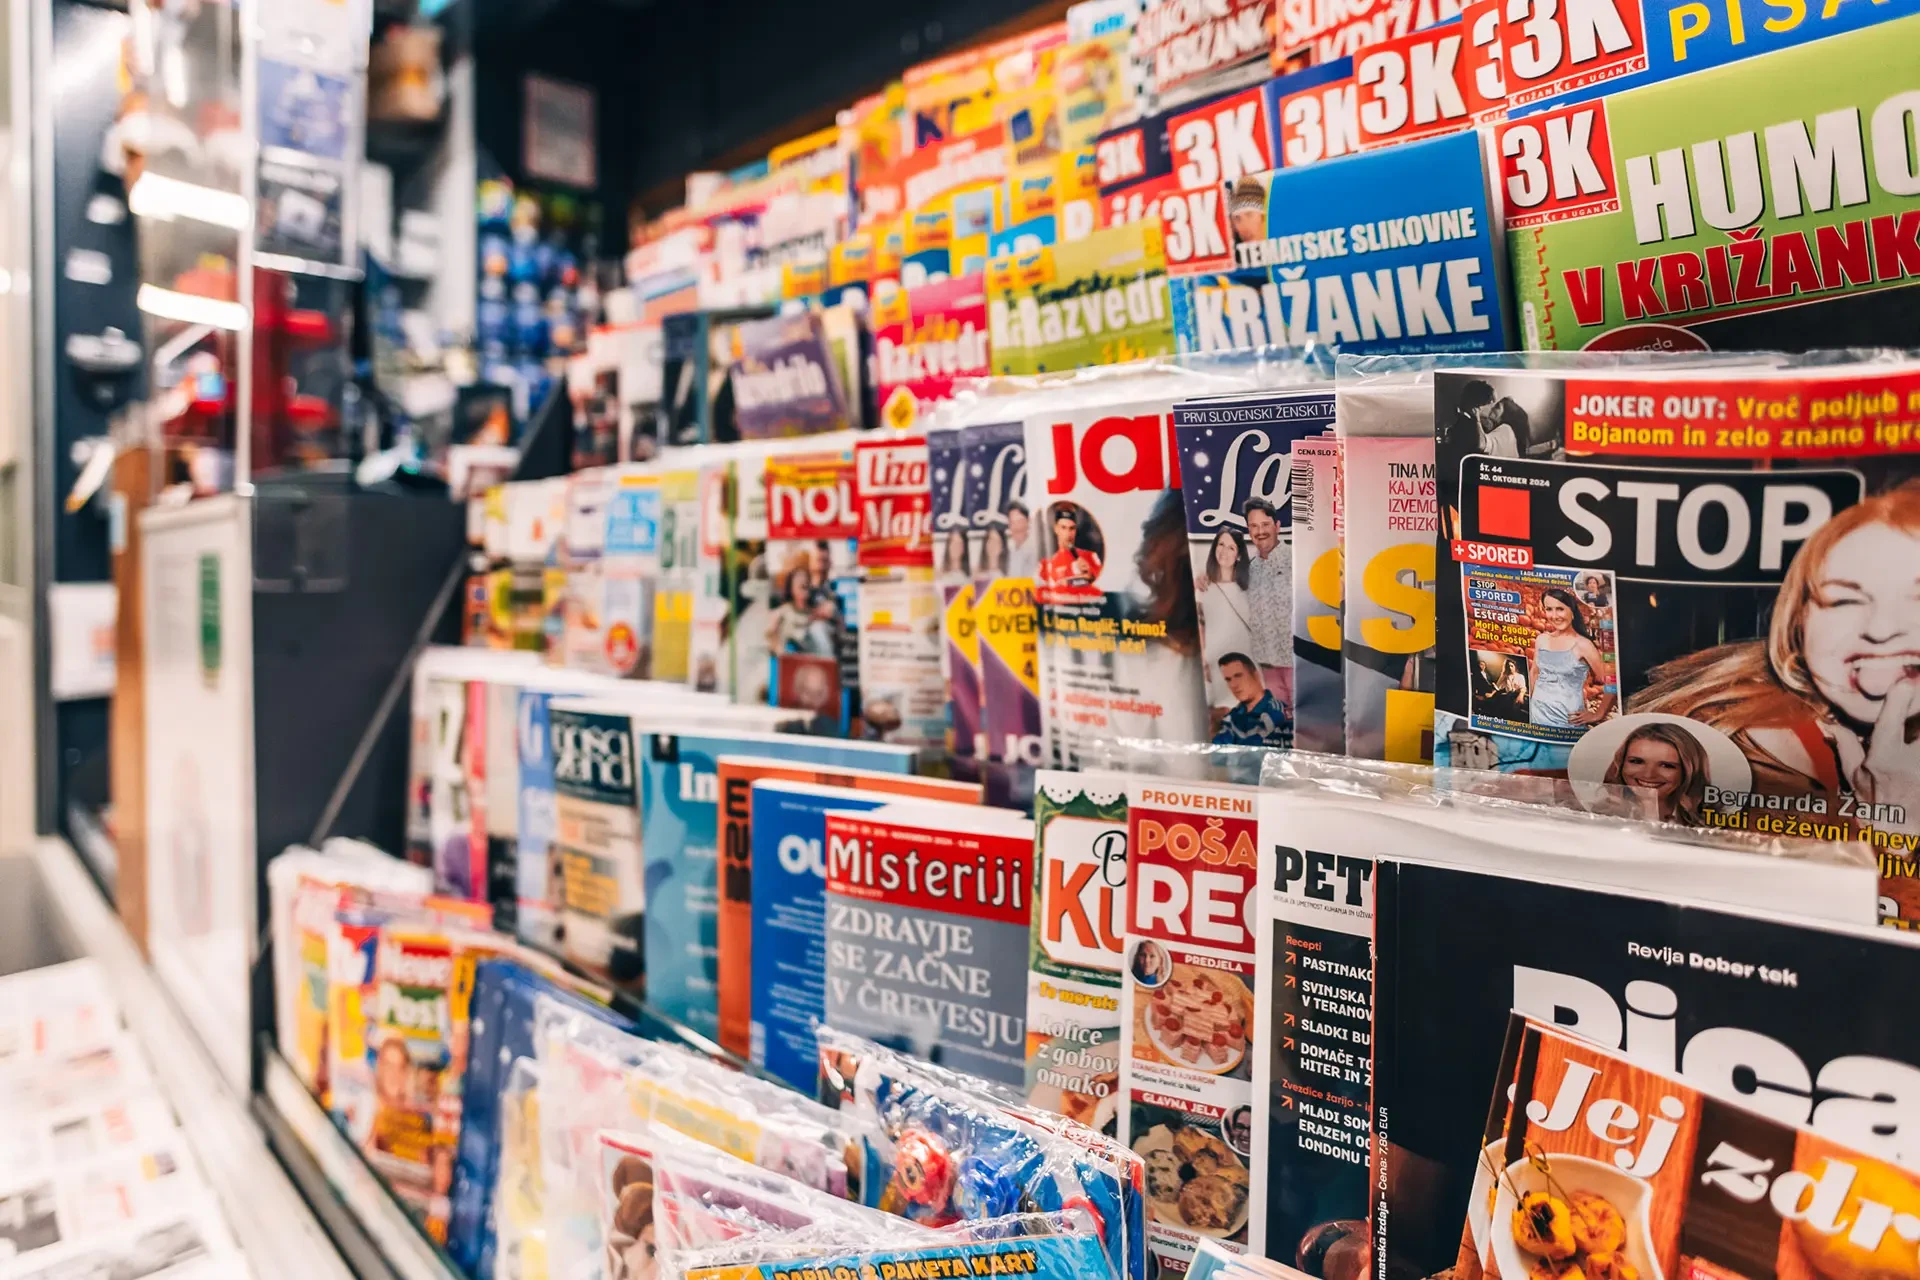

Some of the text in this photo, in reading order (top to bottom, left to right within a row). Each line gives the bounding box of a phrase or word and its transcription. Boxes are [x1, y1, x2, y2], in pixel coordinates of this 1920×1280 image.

[1509, 0, 1633, 80] 3K
[1358, 36, 1467, 136] 3K
[1589, 60, 1644, 83] UGANKE
[1100, 132, 1144, 183] 3K
[1175, 101, 1268, 191] 3K
[1502, 111, 1607, 209] 3K
[1626, 90, 1920, 244] HUMO
[1571, 199, 1620, 217] UGANKE
[1162, 190, 1227, 262] 3K
[1236, 206, 1477, 270] TEMATSKE SLIKOVNE
[1195, 257, 1491, 352] KRIŽANKE
[1562, 266, 1604, 327] V
[1183, 411, 1207, 424] PRVI
[1208, 407, 1274, 422] SLOVENSKI
[1275, 404, 1319, 419] ŽENSKI
[1573, 387, 1899, 424] JOKER OUT: Vroč poljub
[1572, 421, 1673, 447] Bojanom
[1682, 425, 1706, 447] in
[1715, 426, 1770, 447] zelo
[1780, 426, 1865, 448] znano
[1297, 448, 1316, 456] CENA
[1317, 449, 1331, 457] SLO
[870, 452, 925, 487] Liza
[1388, 462, 1419, 479] TINA
[1479, 463, 1491, 472] ŠT.
[1479, 473, 1550, 487] 30. OKTOBER 2024
[1388, 480, 1415, 496] KAJ
[1556, 477, 1833, 571] STOP
[1468, 544, 1529, 565] SPORED
[1475, 590, 1514, 602] SPORED
[1476, 580, 1495, 590] STOP
[1474, 608, 1518, 624] Estrada
[1475, 620, 1500, 632] Morje
[1502, 625, 1530, 638] zgodb
[1475, 631, 1500, 642] Anito
[1142, 789, 1252, 814] PROVERENI
[1703, 785, 1906, 824] Bernarda Žarn
[1138, 817, 1258, 870] POŠA
[1703, 808, 1919, 853] Tudi deževni dnev
[828, 833, 1024, 910] Misteriji
[831, 902, 974, 959] ZDRAVJE
[1285, 935, 1322, 952] Recepti
[831, 938, 868, 974] SE
[872, 948, 992, 998] ZAČNE
[1184, 953, 1244, 973] PREDJELA
[1627, 941, 1799, 989] Revija Dober tek
[1302, 979, 1366, 1006] SVINJSKA
[1302, 994, 1312, 1008] V
[830, 976, 1024, 1049] V ČREVESJU
[1301, 1018, 1371, 1046] SLADKI BU
[1037, 1043, 1049, 1059] z
[1300, 1042, 1354, 1068] DOMAČE
[1036, 1068, 1110, 1098] omako
[1300, 1057, 1341, 1080] HITER
[1344, 1069, 1361, 1084] IN
[1142, 1092, 1220, 1118] GLAVNA JELA
[1281, 1078, 1354, 1108] Zvezdice žarijo
[1299, 1101, 1372, 1133] MLADI SOM
[1299, 1118, 1351, 1144] ERAZEM
[1379, 1106, 1389, 1130] EUR
[1526, 1058, 1685, 1178] Jej
[1298, 1135, 1360, 1165] LONDONU
[1378, 1130, 1389, 1156] 7,80
[1378, 1156, 1388, 1191] Cena:
[1377, 1201, 1390, 1236] izdaja
[879, 1257, 970, 1280] PAKETA
[970, 1251, 1038, 1274] KART
